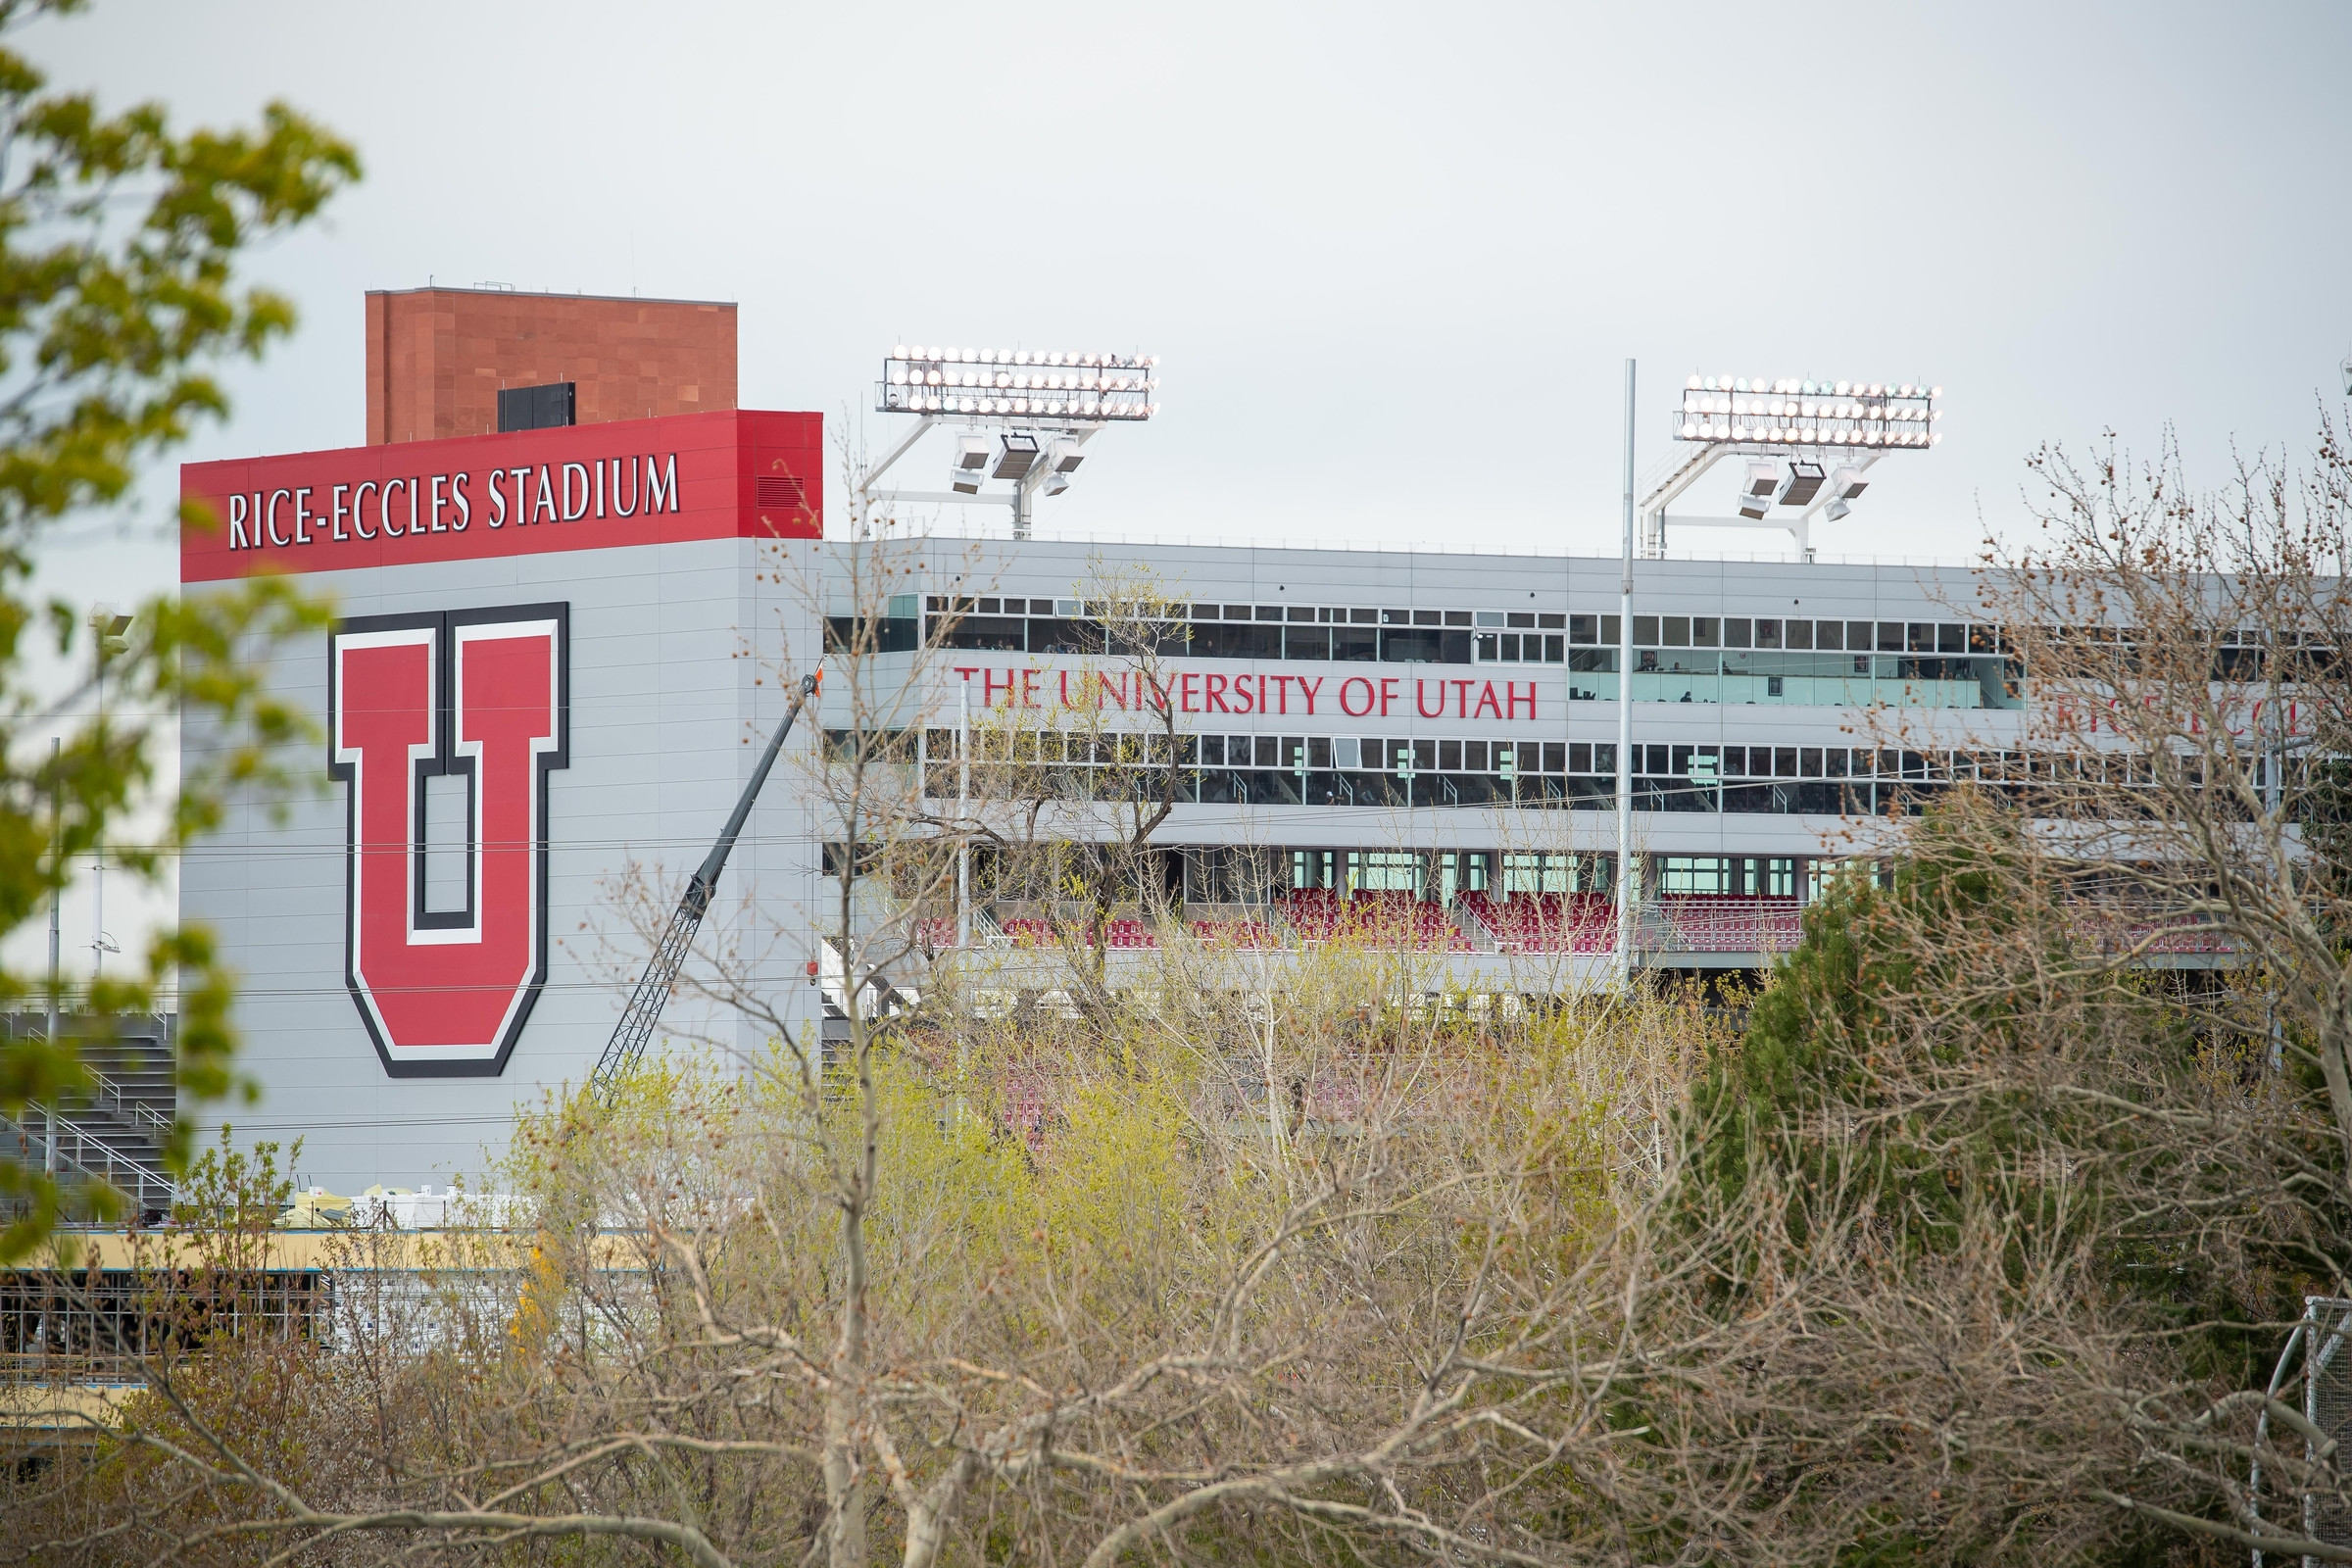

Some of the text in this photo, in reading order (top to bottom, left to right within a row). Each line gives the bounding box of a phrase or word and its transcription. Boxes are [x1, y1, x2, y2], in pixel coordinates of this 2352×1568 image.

[228, 452, 680, 551] RICE-ECCLES STADIUM
[954, 666, 1537, 720] THE UNIVERSITY OF UTAH
[327, 601, 570, 1079] U
